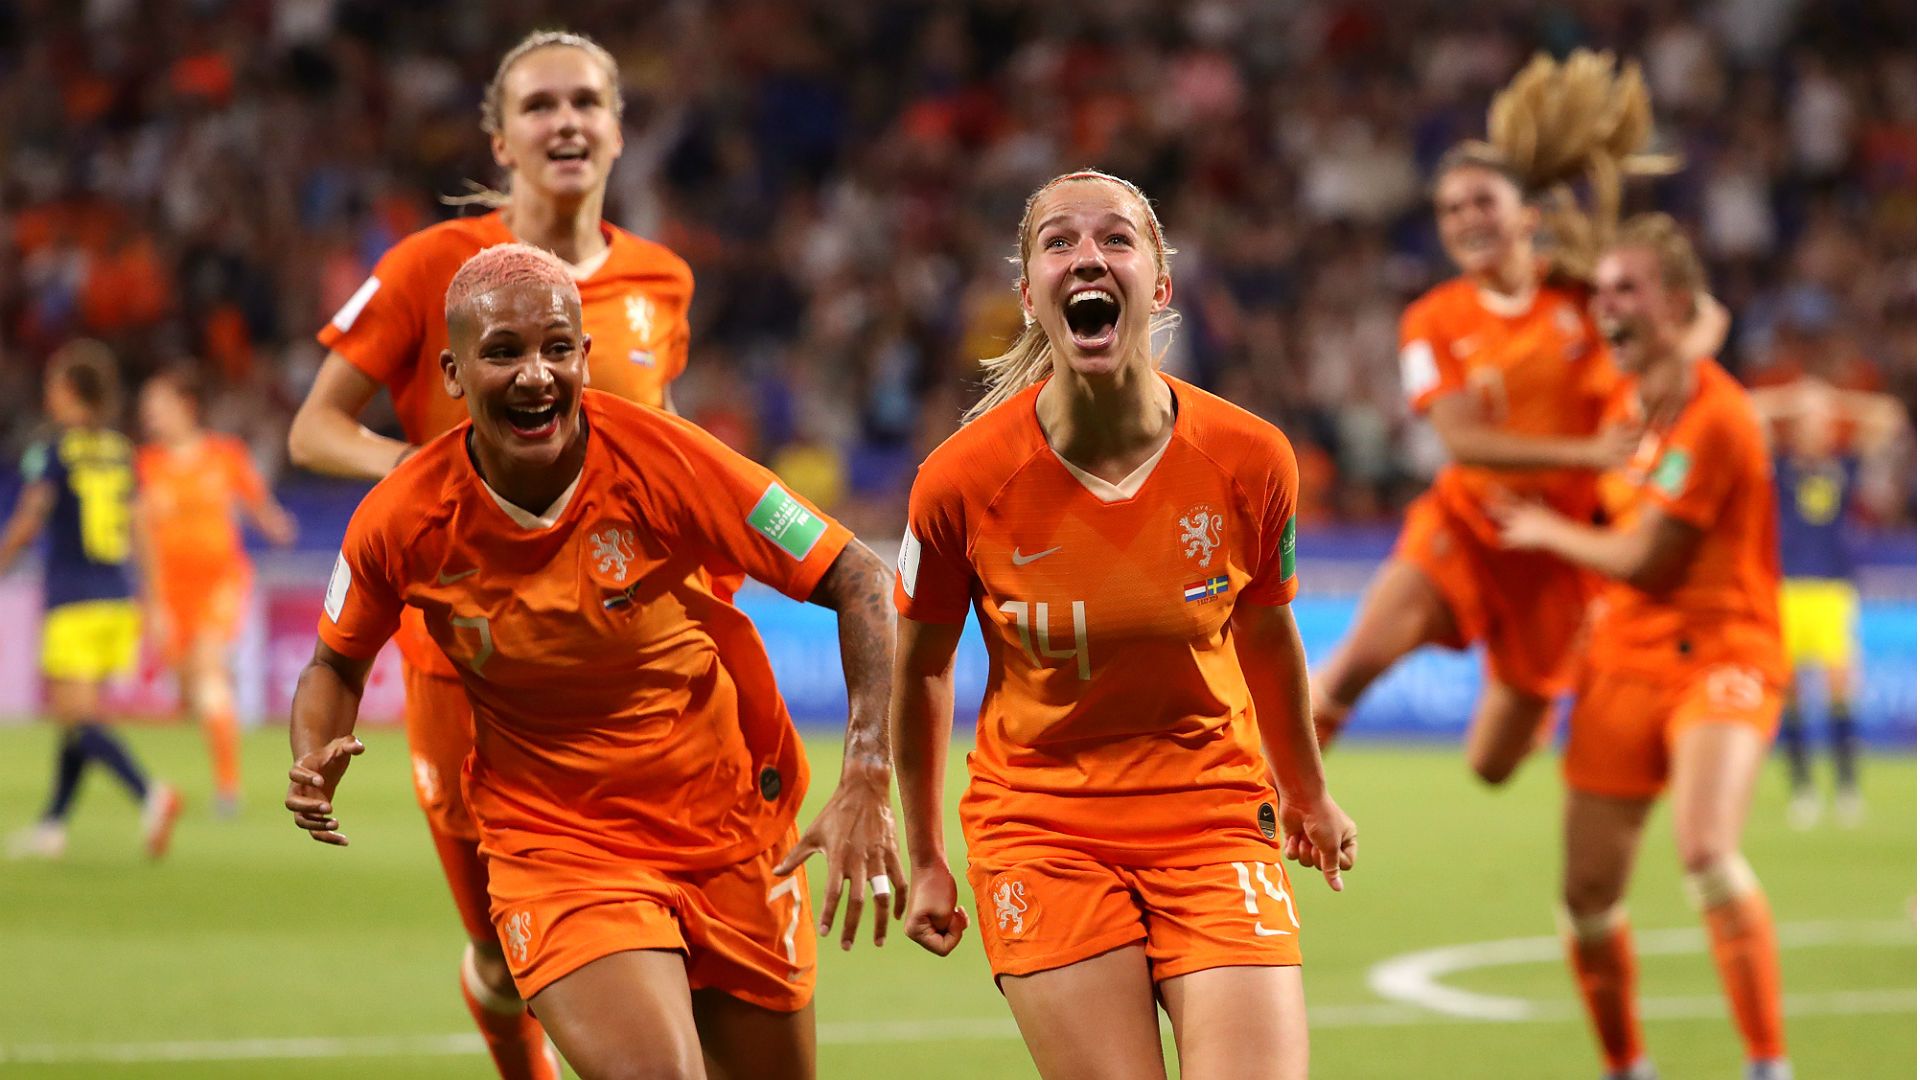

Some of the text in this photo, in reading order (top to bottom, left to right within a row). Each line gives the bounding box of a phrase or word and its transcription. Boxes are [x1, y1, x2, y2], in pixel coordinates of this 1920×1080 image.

[452, 616, 493, 679] 7
[999, 601, 1090, 680] 14
[767, 875, 802, 965] 7
[1231, 862, 1300, 929] 14
